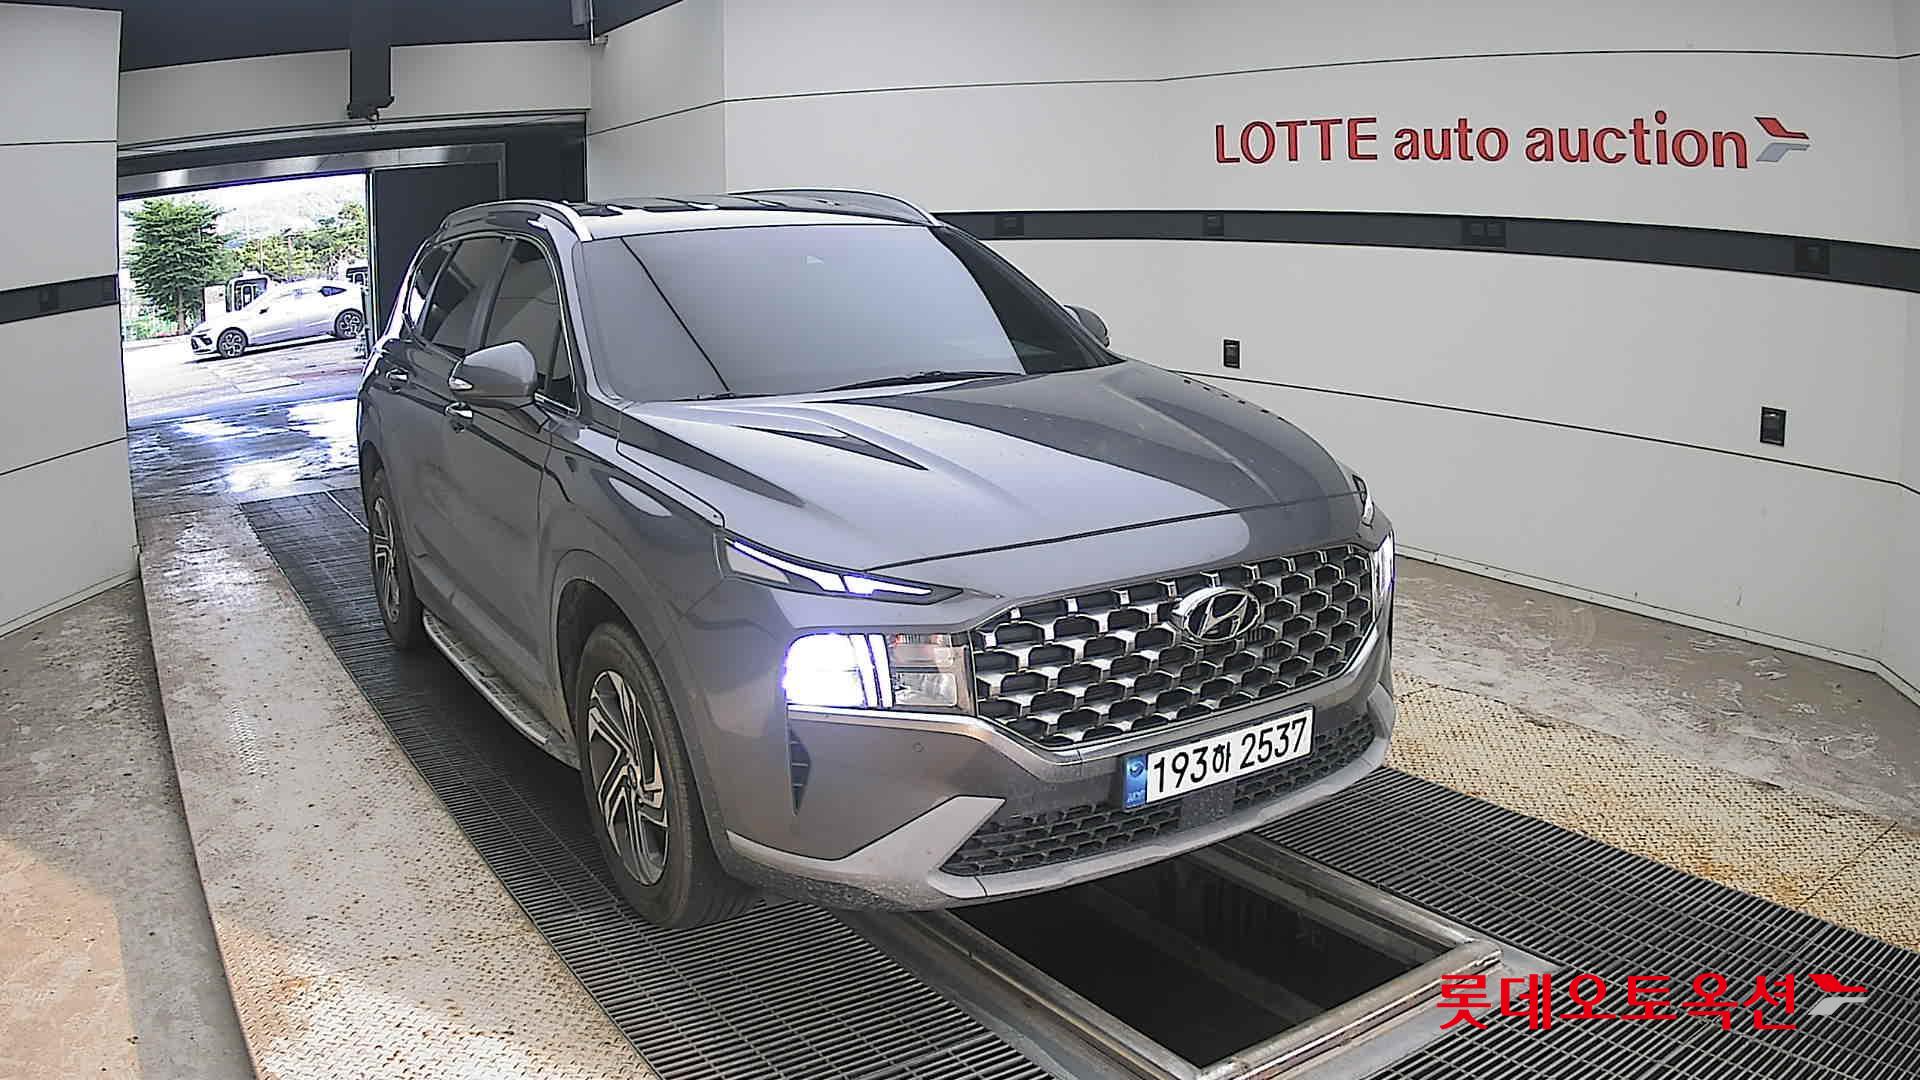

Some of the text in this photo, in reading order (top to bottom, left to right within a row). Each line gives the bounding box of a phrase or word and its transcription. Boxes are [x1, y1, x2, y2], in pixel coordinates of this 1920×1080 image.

[1215, 110, 1748, 169] LOTTE auto auction
[1153, 717, 1307, 793] 193하 2537
